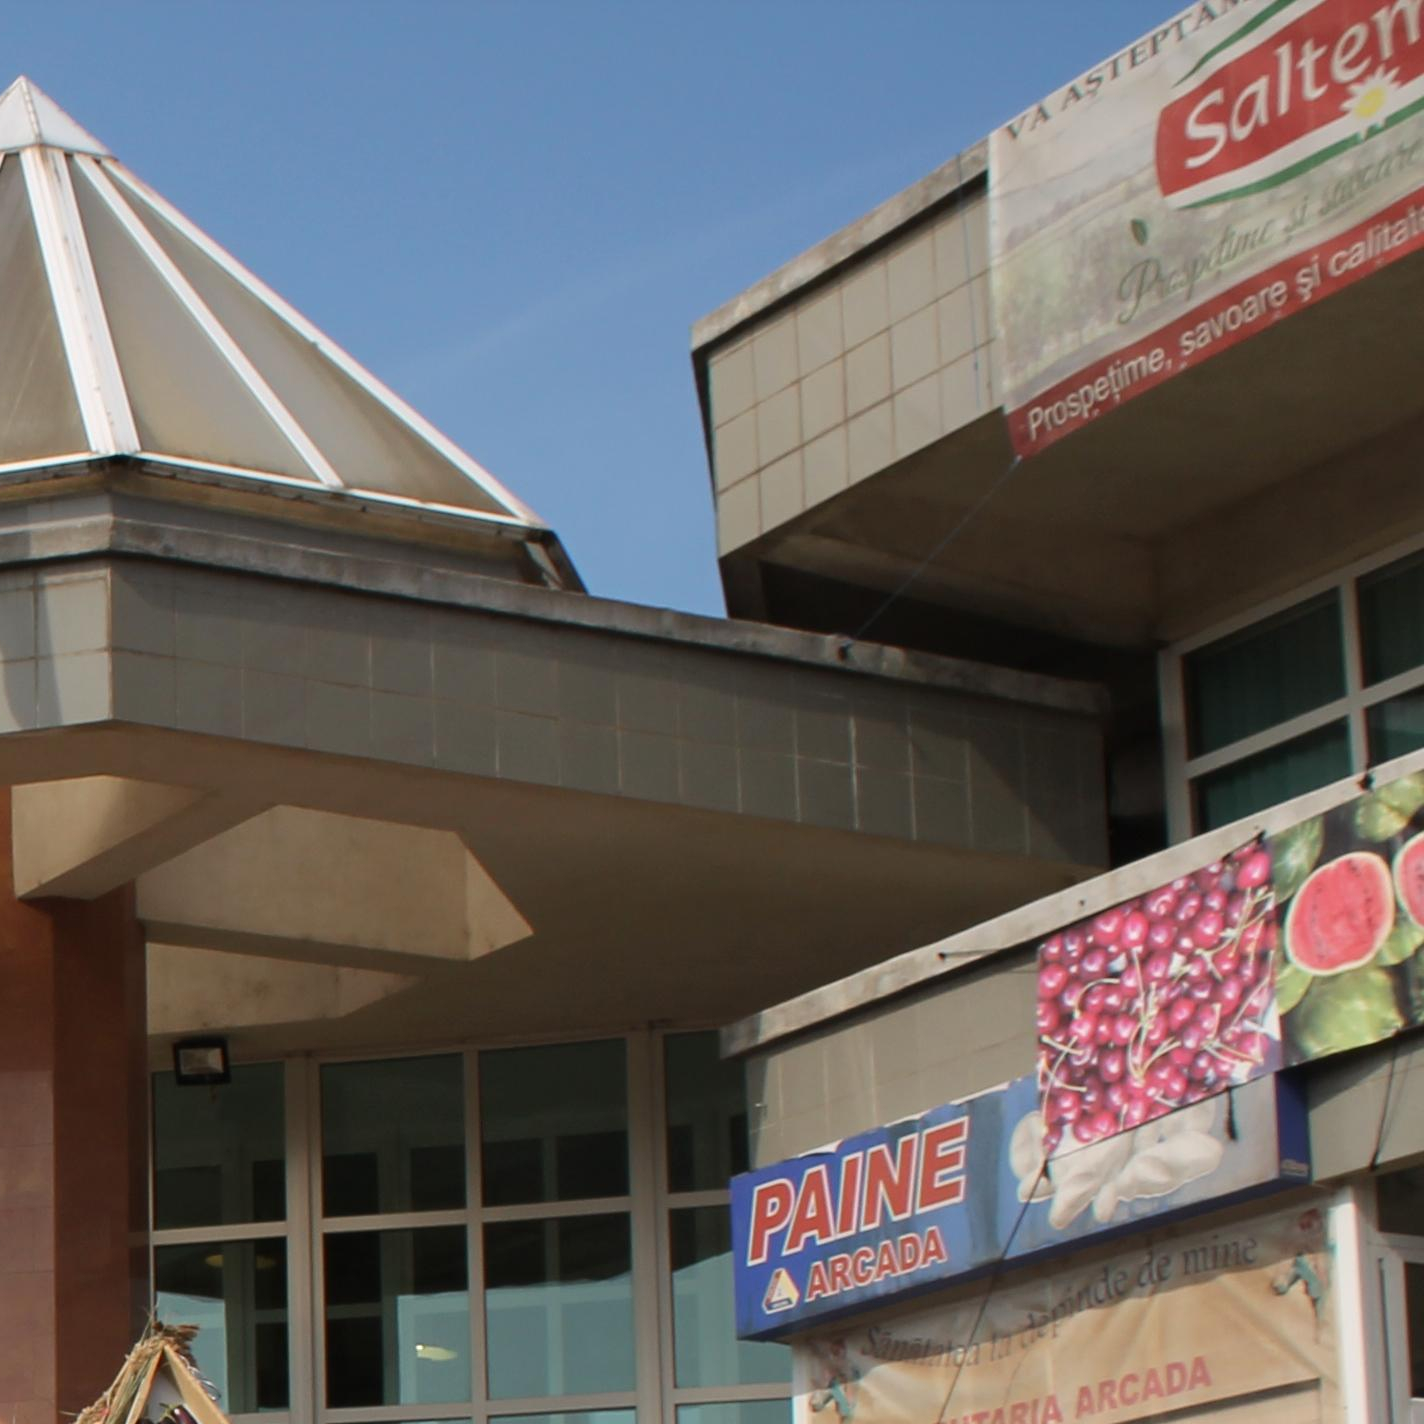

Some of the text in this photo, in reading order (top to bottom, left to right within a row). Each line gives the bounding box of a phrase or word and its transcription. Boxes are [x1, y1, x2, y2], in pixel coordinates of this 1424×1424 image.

[1179, 280, 1288, 357] savoare
[747, 1115, 970, 1267] PAINE
[804, 1225, 947, 1303] ARCADA
[1137, 1248, 1171, 1288] de
[1183, 1233, 1258, 1276] mine
[1075, 1355, 1213, 1419] ARCADA
